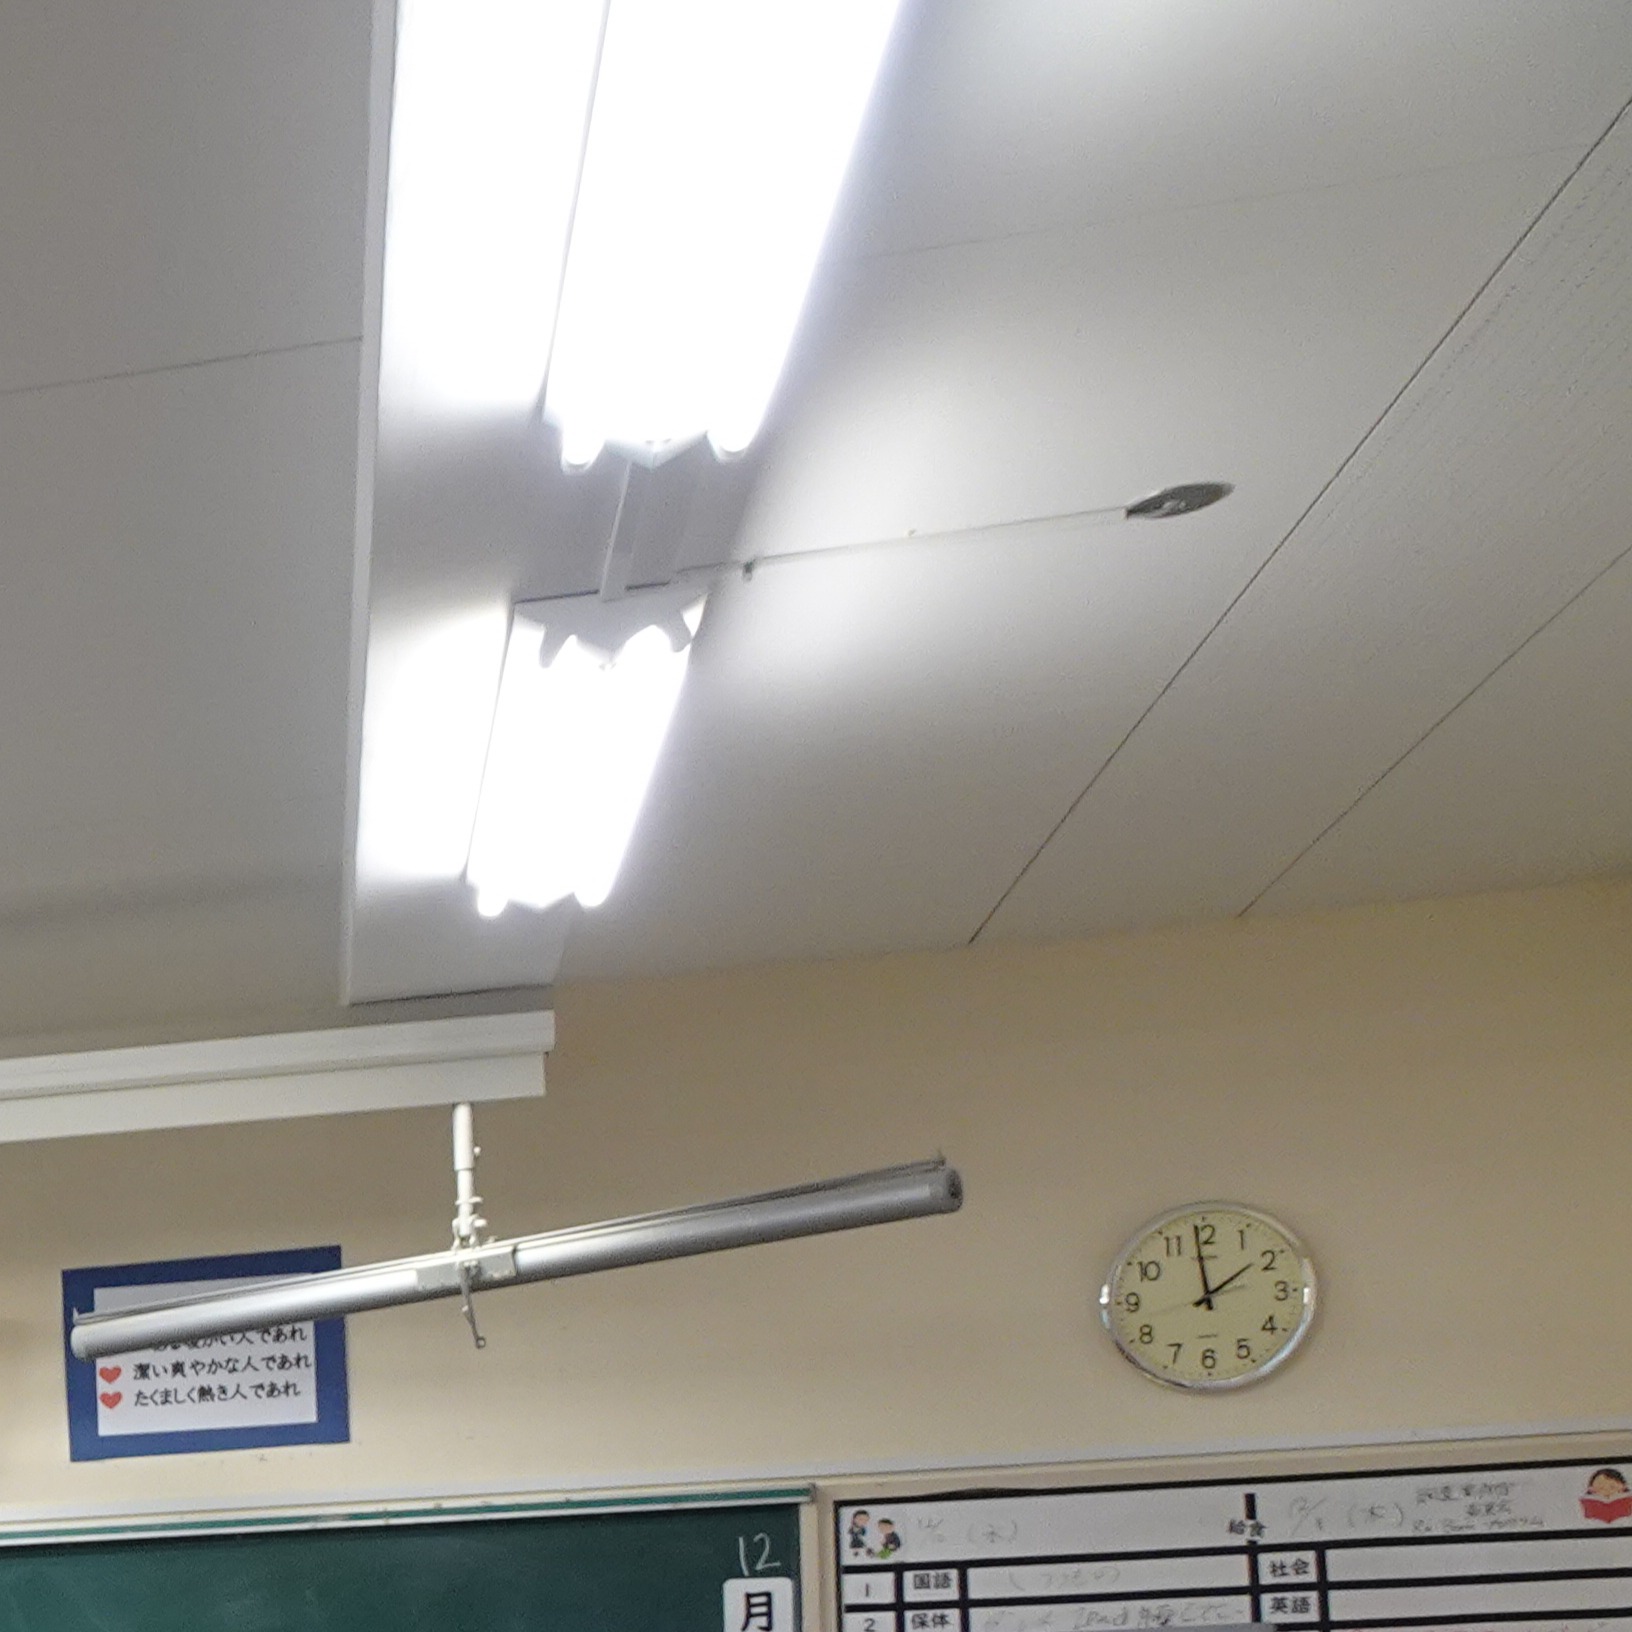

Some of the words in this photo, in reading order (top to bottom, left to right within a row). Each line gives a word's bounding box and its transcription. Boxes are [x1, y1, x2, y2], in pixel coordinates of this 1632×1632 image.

[1193, 1224, 1216, 1246] 2
[1237, 1229, 1245, 1251] 1
[1164, 1235, 1182, 1258] 11
[1137, 1260, 1161, 1283] 10
[1260, 1250, 1277, 1272] 2
[1274, 1280, 1289, 1302] 3
[1124, 1292, 1141, 1313] 9
[1139, 1324, 1155, 1345] 8
[1260, 1315, 1277, 1336] 4
[1167, 1343, 1184, 1365] 7
[1201, 1349, 1217, 1370] 6
[1236, 1338, 1251, 1360] 5
[133, 1353, 312, 1381] 潔い爽やかな人であれ
[133, 1382, 301, 1408] たくましく熱き人であれ
[737, 1531, 782, 1577] 12
[1269, 1557, 1310, 1578] 社会
[913, 1572, 953, 1591] 国語
[1270, 1597, 1311, 1615] 英語
[911, 1612, 952, 1631] 保体
